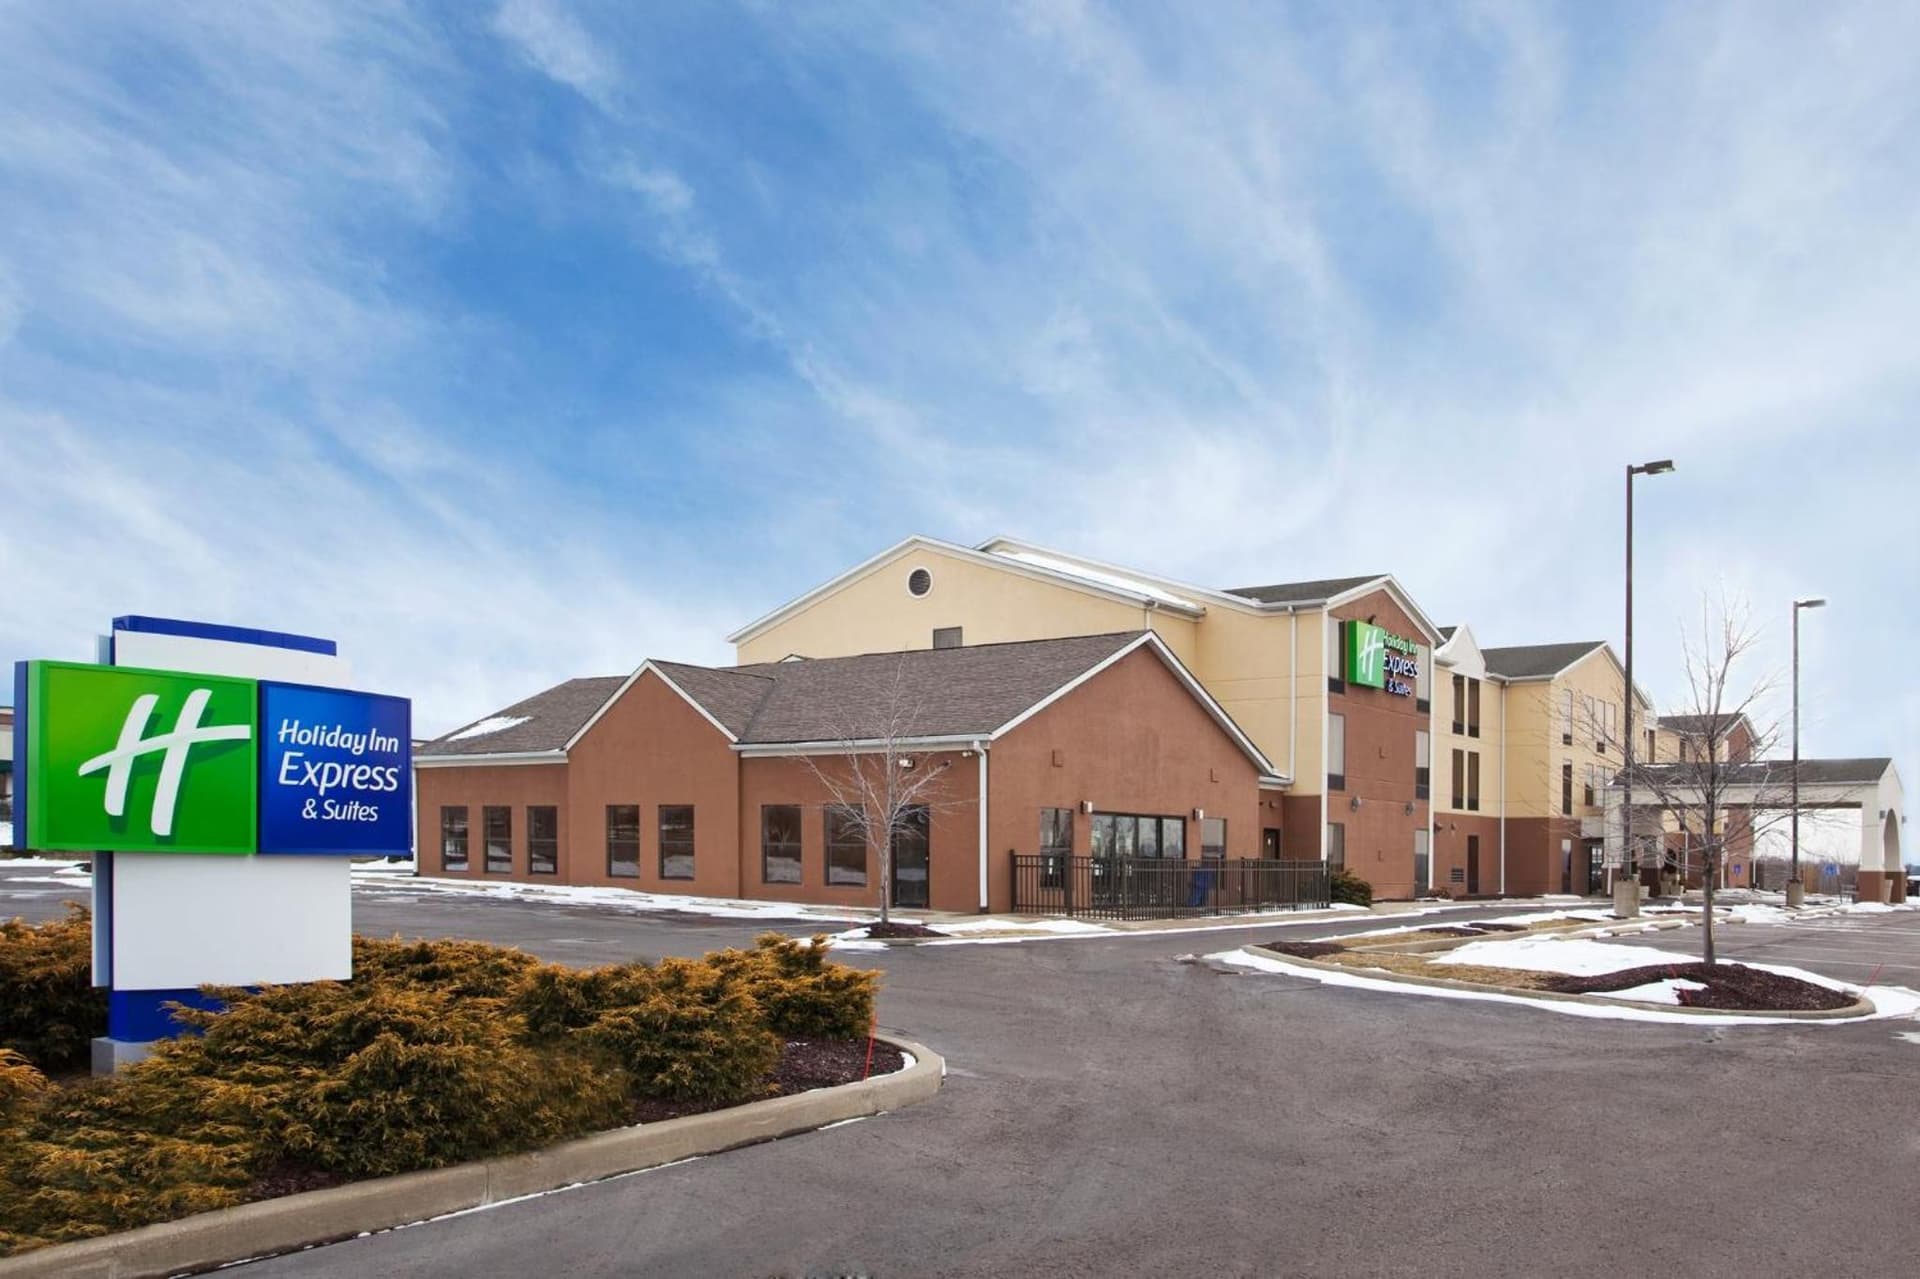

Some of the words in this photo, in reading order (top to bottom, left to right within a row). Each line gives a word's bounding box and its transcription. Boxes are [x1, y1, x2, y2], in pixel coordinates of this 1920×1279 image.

[1383, 649, 1419, 679] Express
[278, 718, 366, 755] Holiday
[368, 728, 399, 753] Inn
[278, 751, 399, 796] Express
[302, 798, 318, 820] &
[321, 799, 379, 822] Suites
